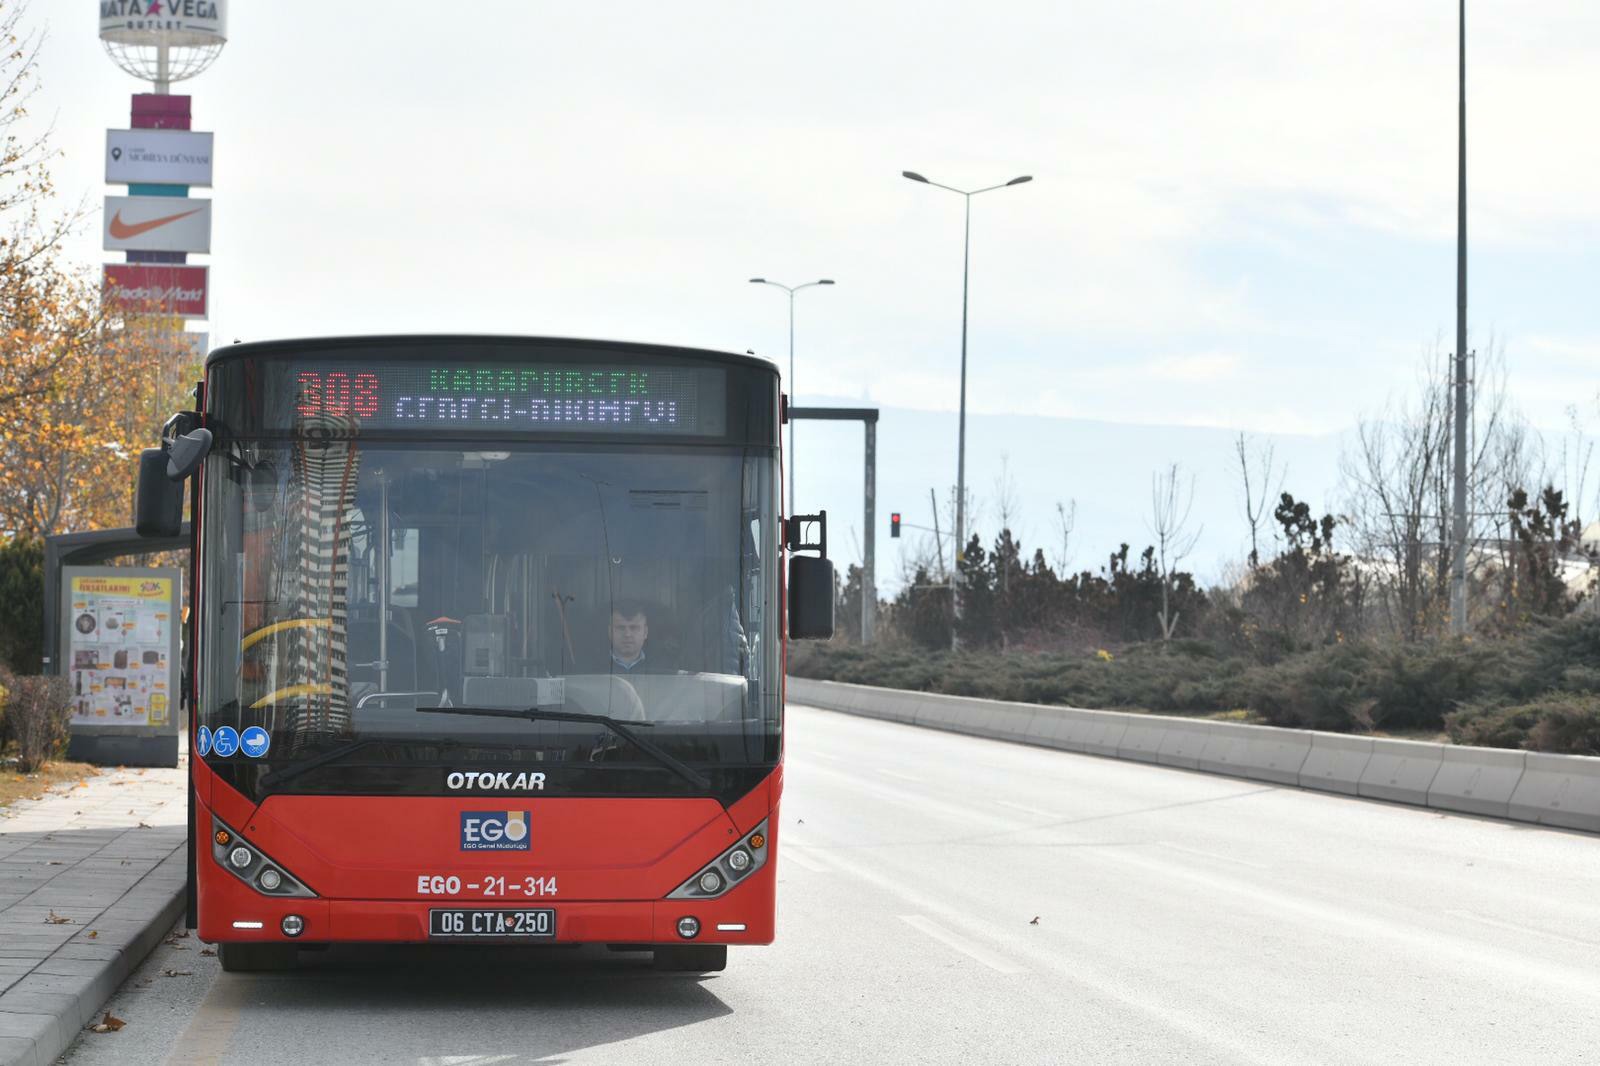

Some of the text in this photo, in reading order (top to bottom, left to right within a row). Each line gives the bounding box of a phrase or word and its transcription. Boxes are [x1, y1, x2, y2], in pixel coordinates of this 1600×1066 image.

[167, 0, 218, 20] VEGA
[126, 20, 182, 30] OUTLET
[297, 372, 379, 418] 308
[447, 772, 546, 790] OTOKAR
[464, 819, 527, 842] EGO
[442, 913, 548, 933] 06 CTA 250
